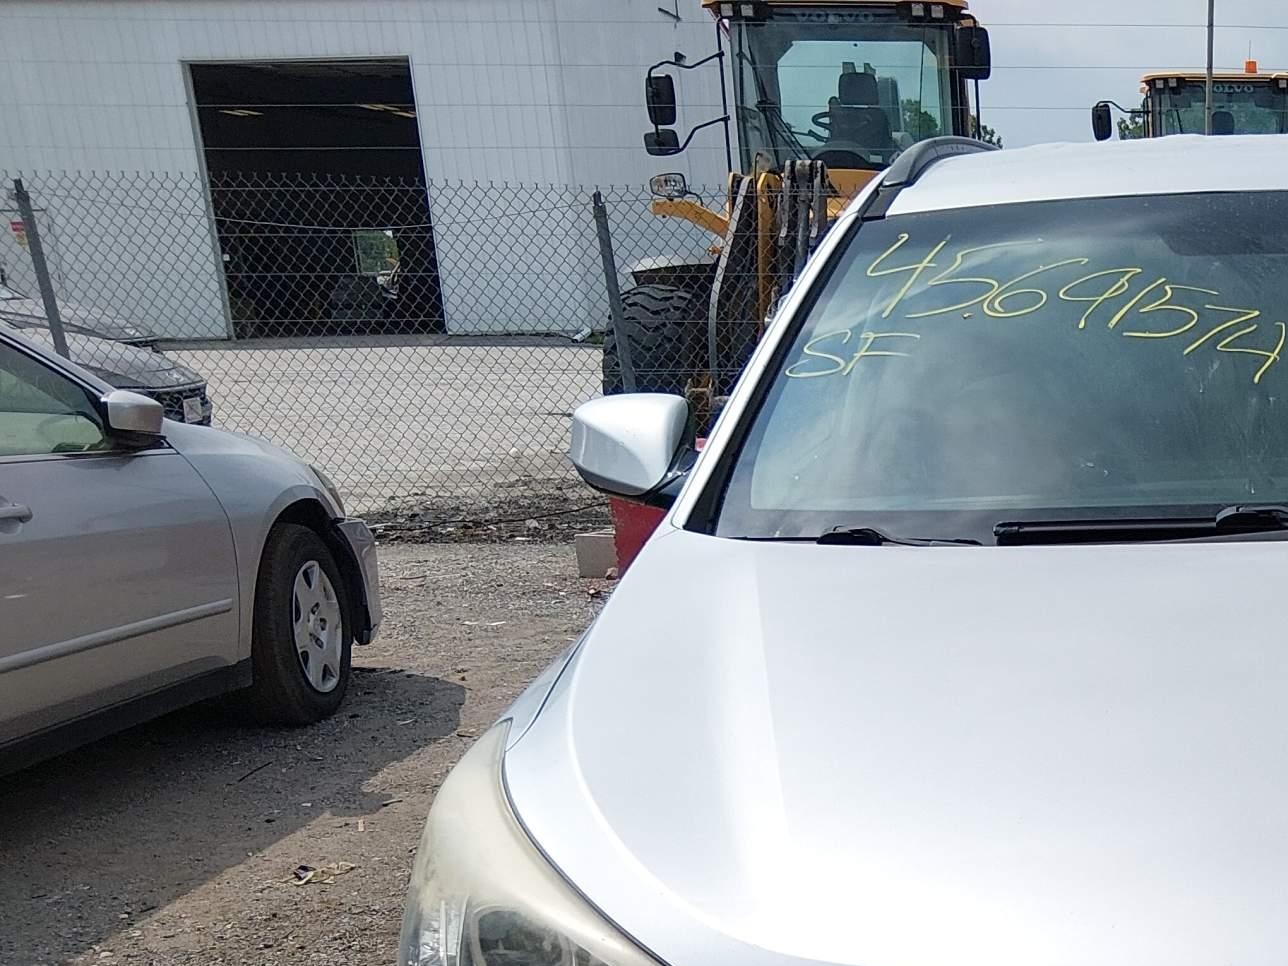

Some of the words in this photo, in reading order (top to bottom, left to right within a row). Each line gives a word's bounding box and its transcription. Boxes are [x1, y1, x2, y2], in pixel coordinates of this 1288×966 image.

[1206, 84, 1254, 93] OLVO
[866, 233, 1286, 384] 45691574
[785, 329, 921, 378] SF
